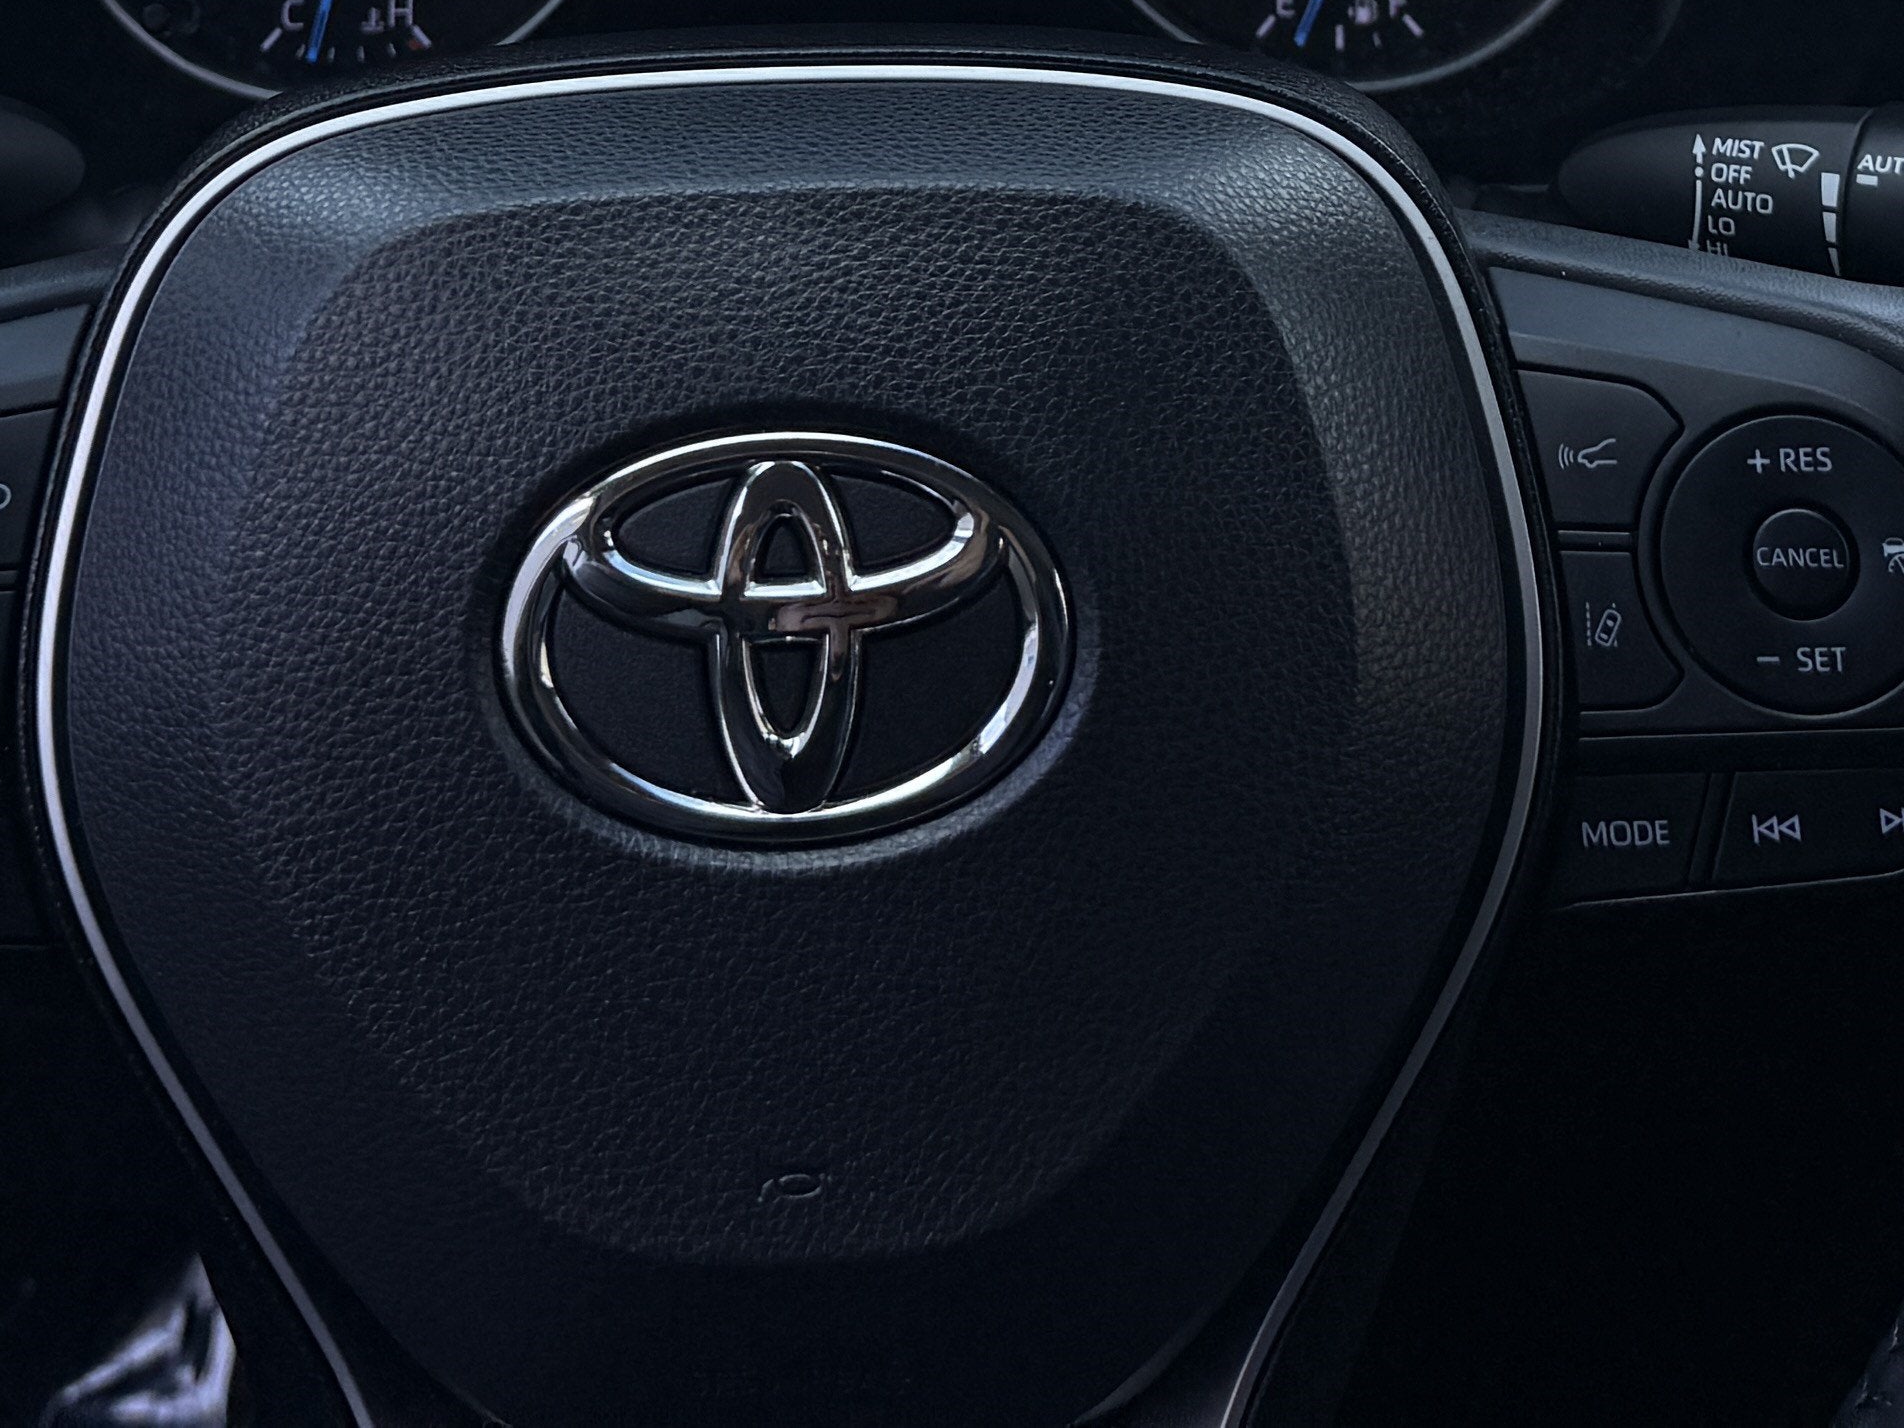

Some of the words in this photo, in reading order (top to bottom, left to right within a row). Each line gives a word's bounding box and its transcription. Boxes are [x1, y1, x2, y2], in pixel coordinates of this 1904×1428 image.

[1711, 137, 1765, 160] MIST
[1710, 162, 1753, 185] OFF
[1710, 188, 1774, 215] AUTO
[1707, 215, 1736, 236] LO
[1756, 546, 1844, 568] CANCEL
[1581, 819, 1670, 847] MODE
